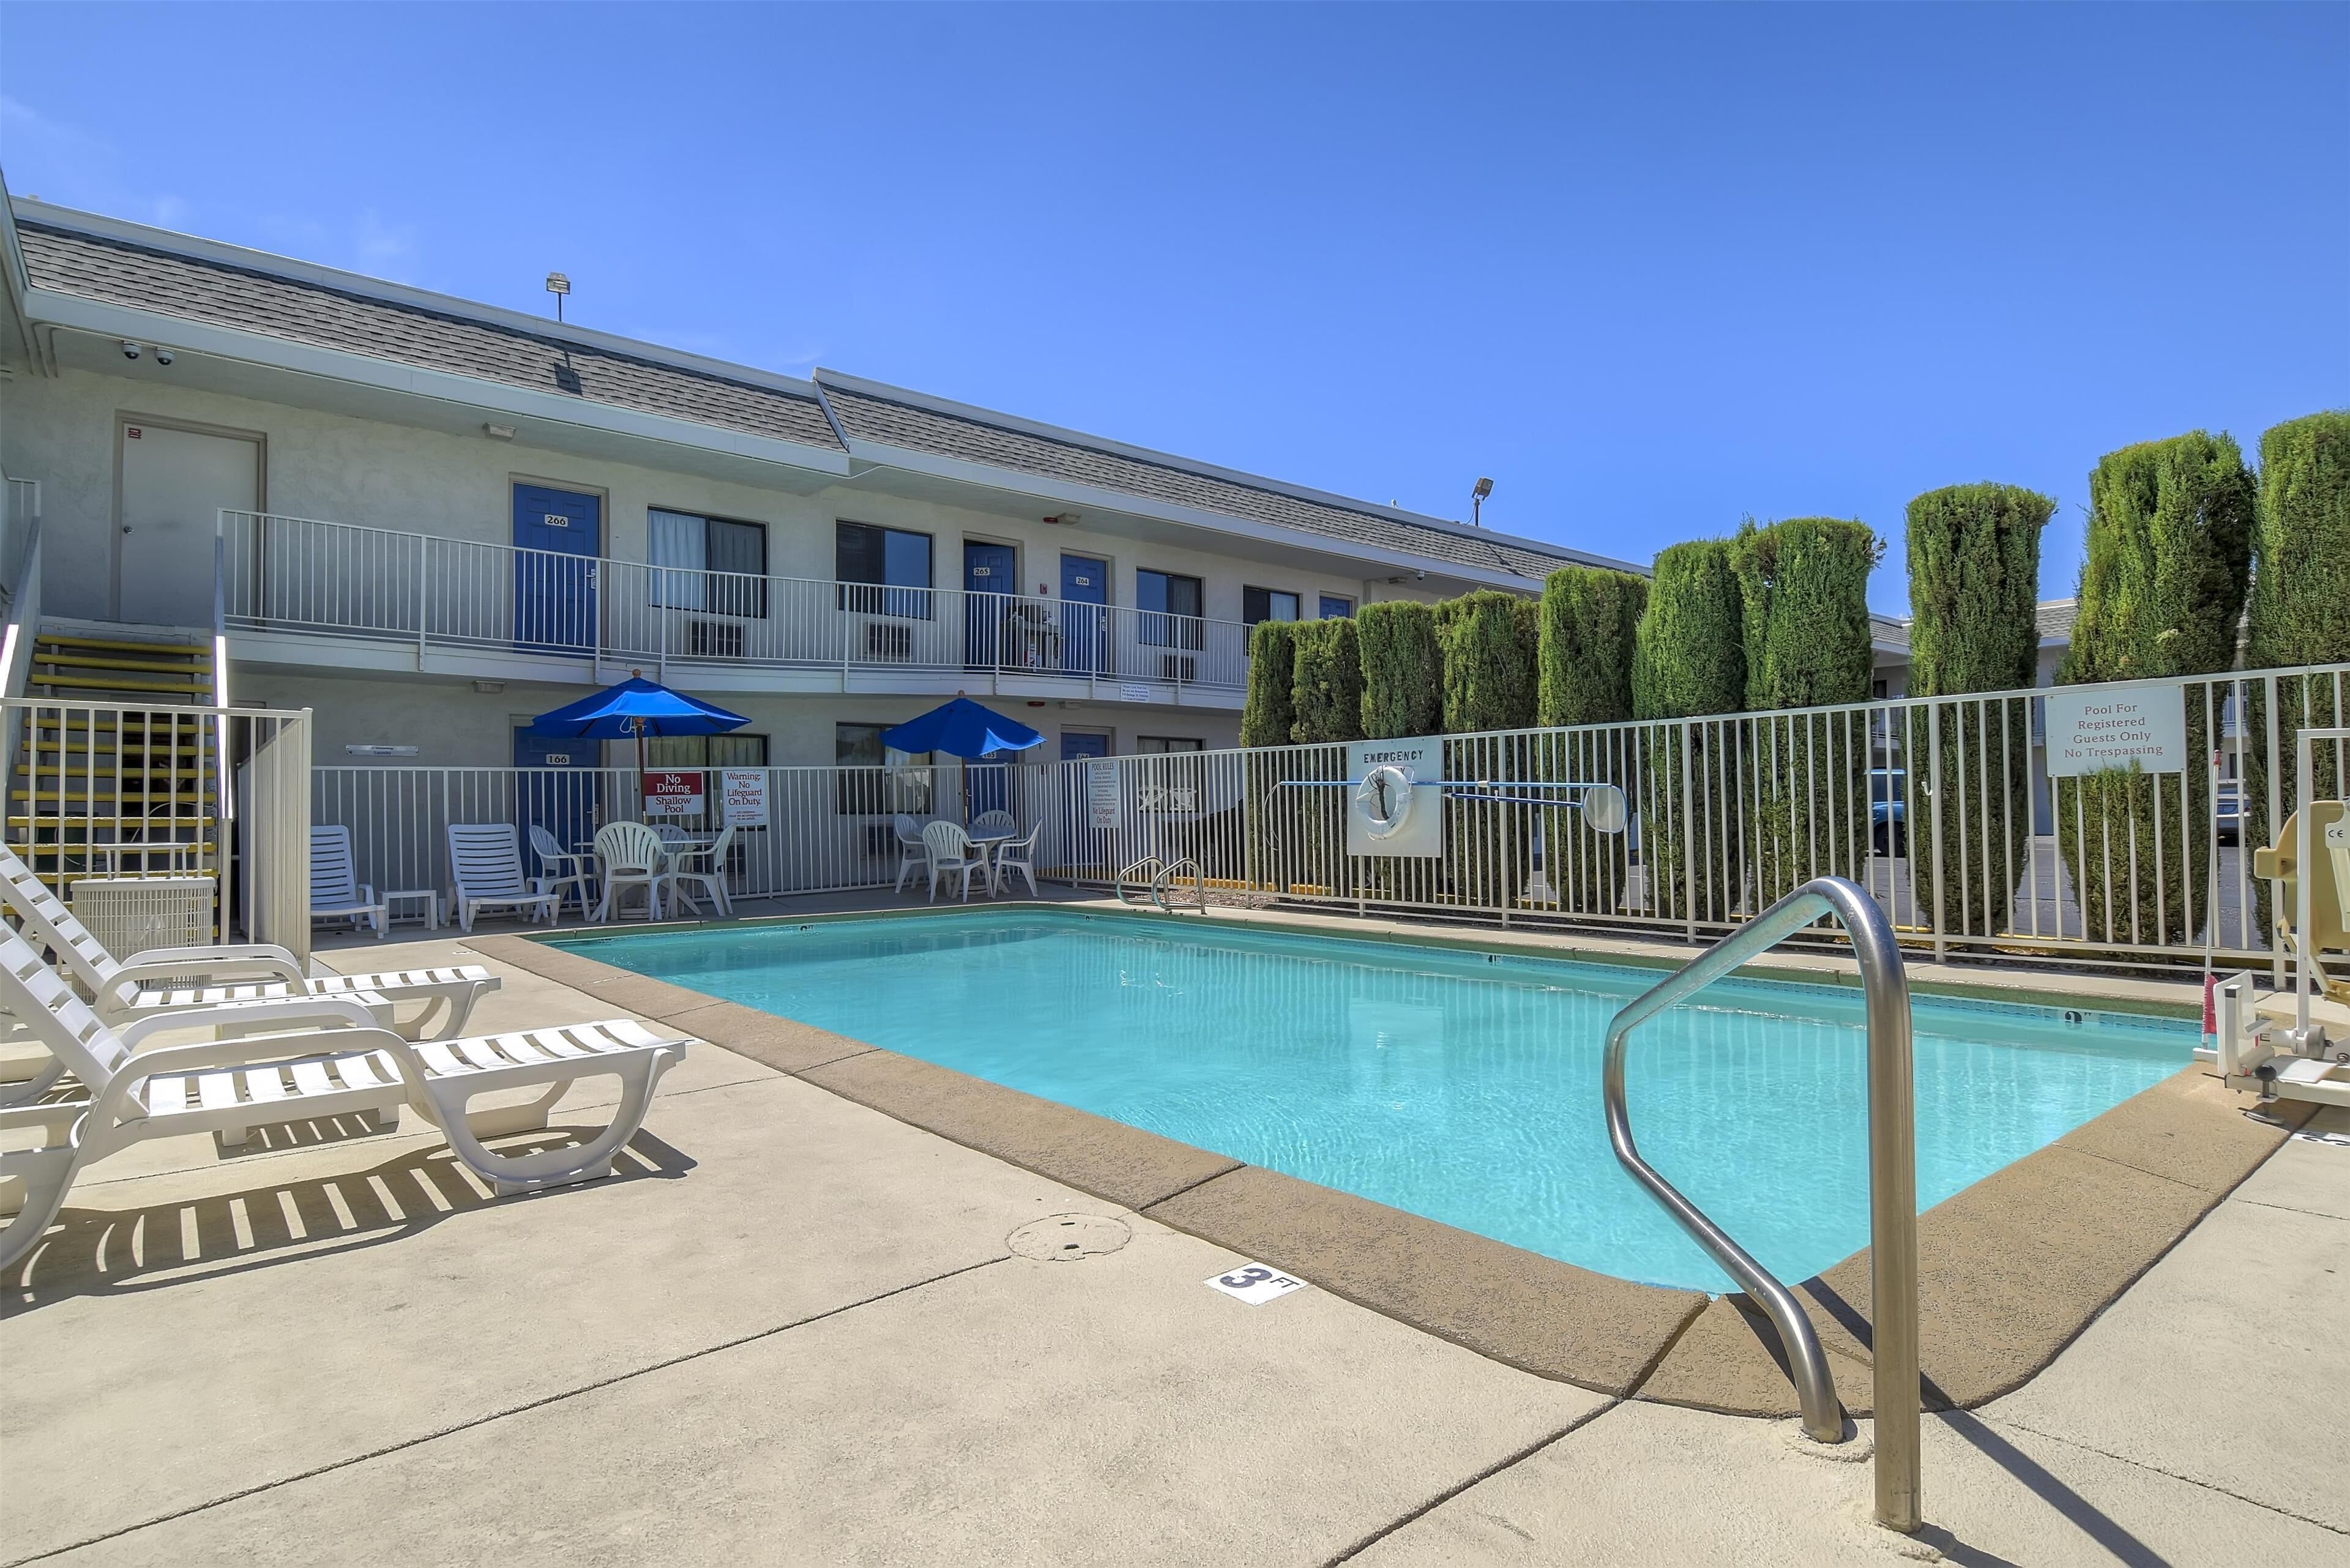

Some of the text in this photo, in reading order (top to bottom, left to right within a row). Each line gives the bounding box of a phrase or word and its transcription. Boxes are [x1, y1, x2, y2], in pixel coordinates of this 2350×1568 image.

[548, 516, 565, 525] 266
[2085, 704, 2138, 715] Pool For
[2078, 717, 2145, 730] Registered
[2073, 731, 2151, 744] Guests Only
[1364, 750, 1423, 763] EMERGENCY
[2065, 745, 2163, 758] No Trespassing
[666, 774, 681, 783] No
[727, 772, 761, 781] Warning:
[657, 783, 690, 794] Diving
[728, 789, 761, 798] Lifeguard
[656, 796, 691, 805] Shallow
[1099, 807, 1115, 816] Lifeguard
[1103, 816, 1111, 825] Duty
[1220, 1268, 1300, 1288] 3 FT
